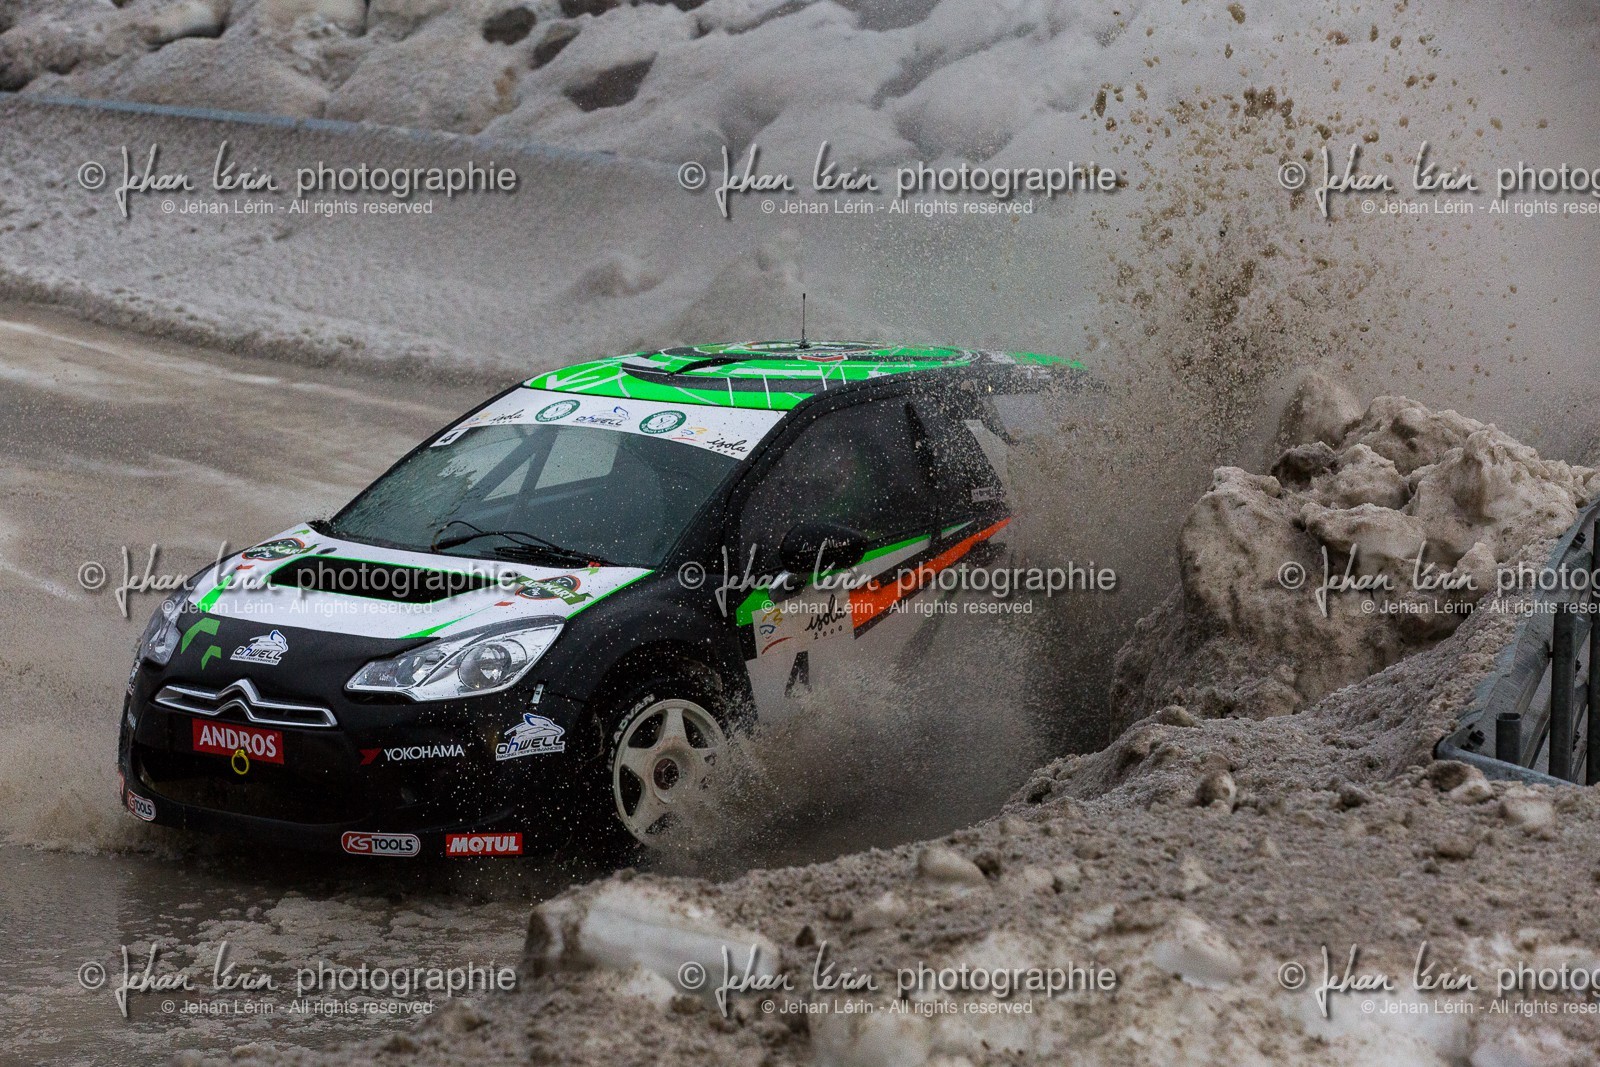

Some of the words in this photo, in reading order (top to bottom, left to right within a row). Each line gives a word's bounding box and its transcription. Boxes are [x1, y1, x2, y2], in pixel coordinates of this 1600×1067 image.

[707, 437, 748, 452] isola
[804, 593, 847, 631] isola
[814, 624, 843, 640] 2000
[200, 725, 277, 758] ANDROS
[384, 744, 466, 761] YOKOHAMA
[496, 751, 517, 759] RACING
[372, 838, 413, 851] TOOLS
[449, 835, 520, 853] MOTUL
